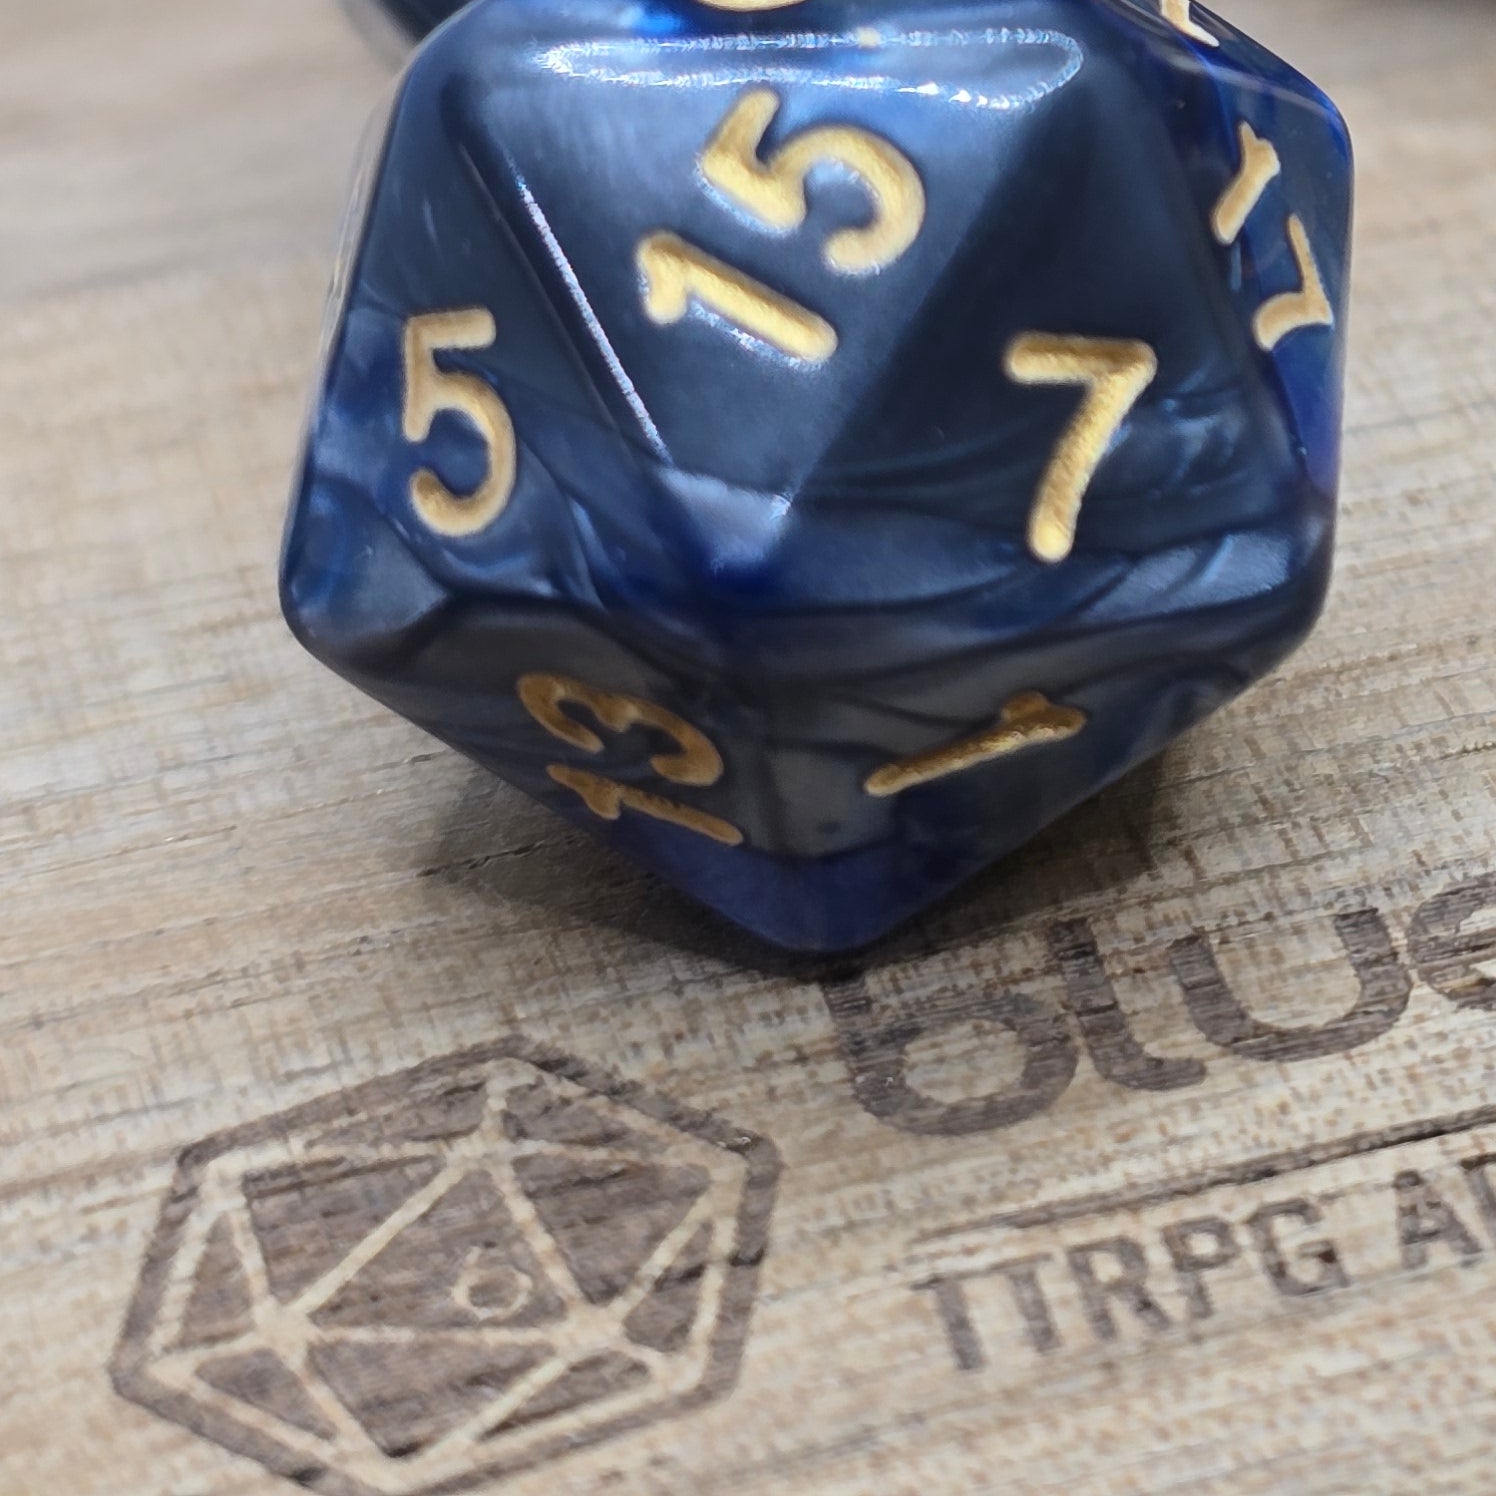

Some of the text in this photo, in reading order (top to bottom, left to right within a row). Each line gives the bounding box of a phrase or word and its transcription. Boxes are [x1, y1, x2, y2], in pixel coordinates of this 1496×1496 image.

[636, 90, 924, 363] 15
[1210, 120, 1334, 351] 17
[404, 307, 517, 536] 5
[1005, 332, 1157, 563] 7
[516, 672, 744, 846] 13
[863, 691, 1086, 797] 1
[913, 1195, 1349, 1370] TTRPG
